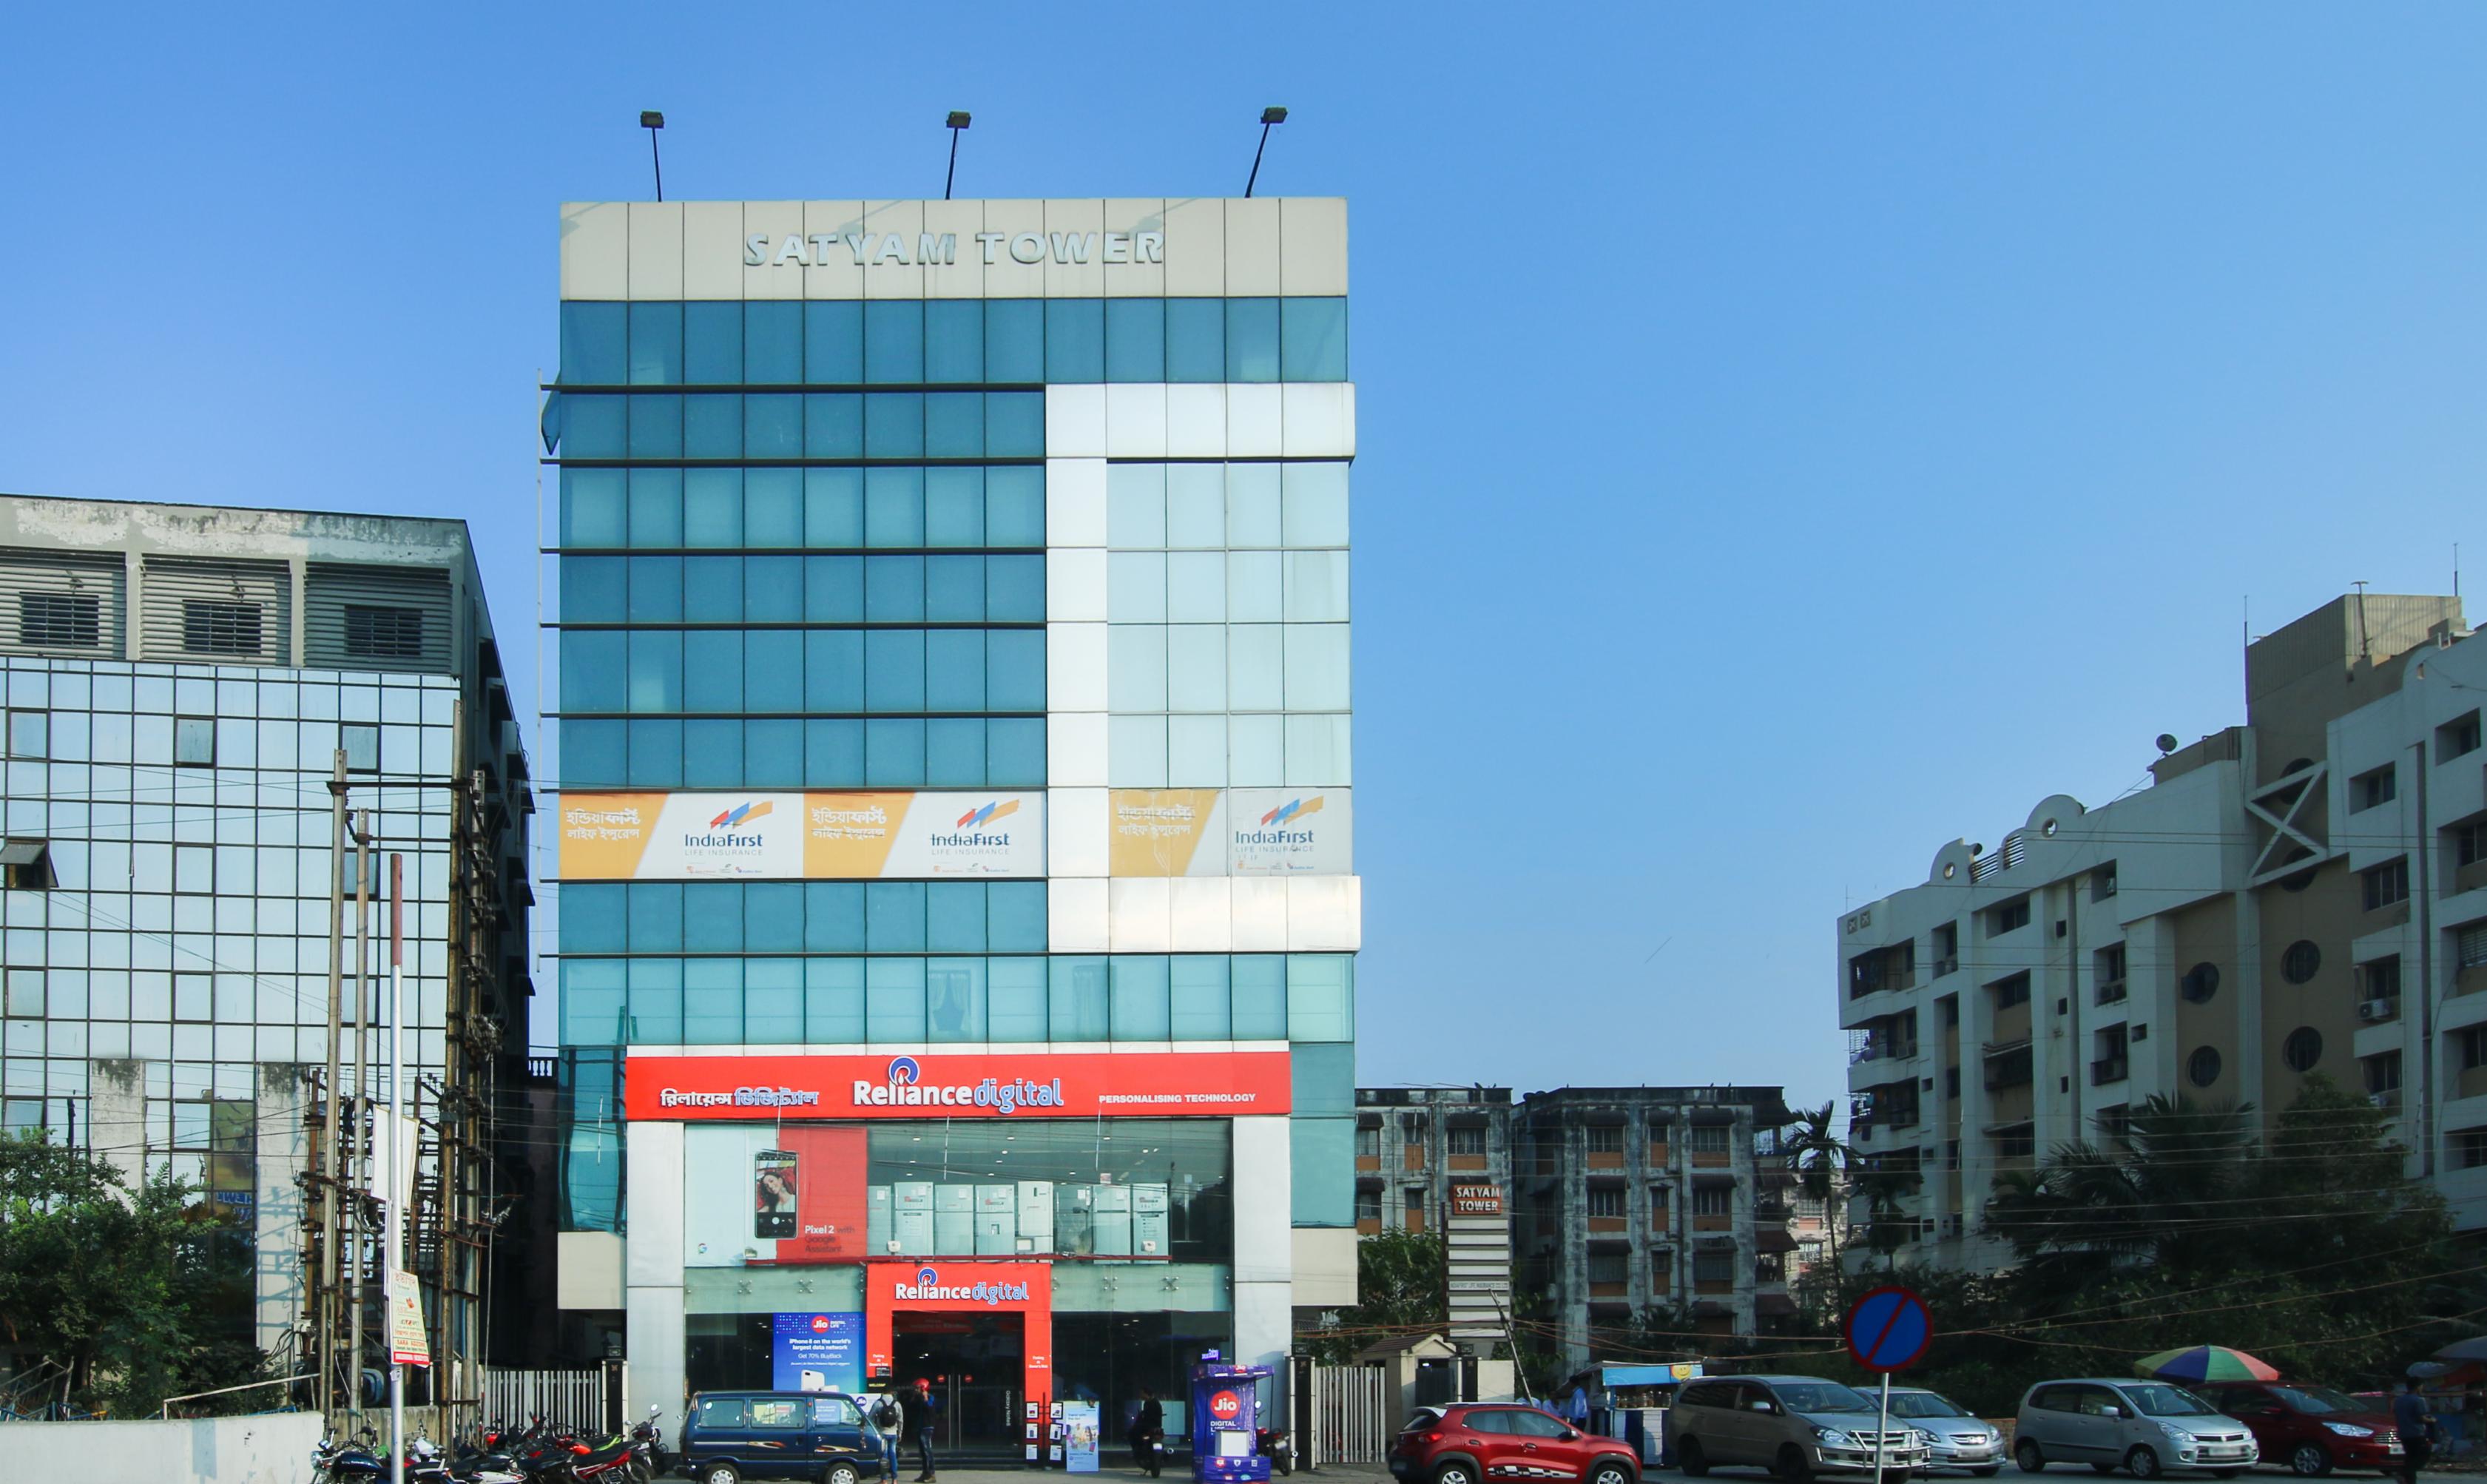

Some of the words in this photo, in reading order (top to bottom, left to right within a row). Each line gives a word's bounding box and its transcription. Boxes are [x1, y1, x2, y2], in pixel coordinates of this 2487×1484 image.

[744, 232, 956, 266] SATYAM
[975, 232, 1164, 265] TOWER
[685, 833, 763, 847] IndiaFirst
[932, 833, 1010, 846] IndiaFirst
[1236, 830, 1314, 843] IndiaFirst
[1099, 1094, 1182, 1104] PERSONALISING
[1184, 1093, 1256, 1103] TECHNOLOGY
[1456, 1187, 1500, 1198] SATYAM
[1459, 1201, 1499, 1211] TOWER
[805, 1226, 827, 1234] Pixel
[828, 1226, 834, 1234] 2
[804, 1235, 836, 1244] Google
[813, 1320, 828, 1329] Jio
[1214, 1397, 1237, 1412] Jio
